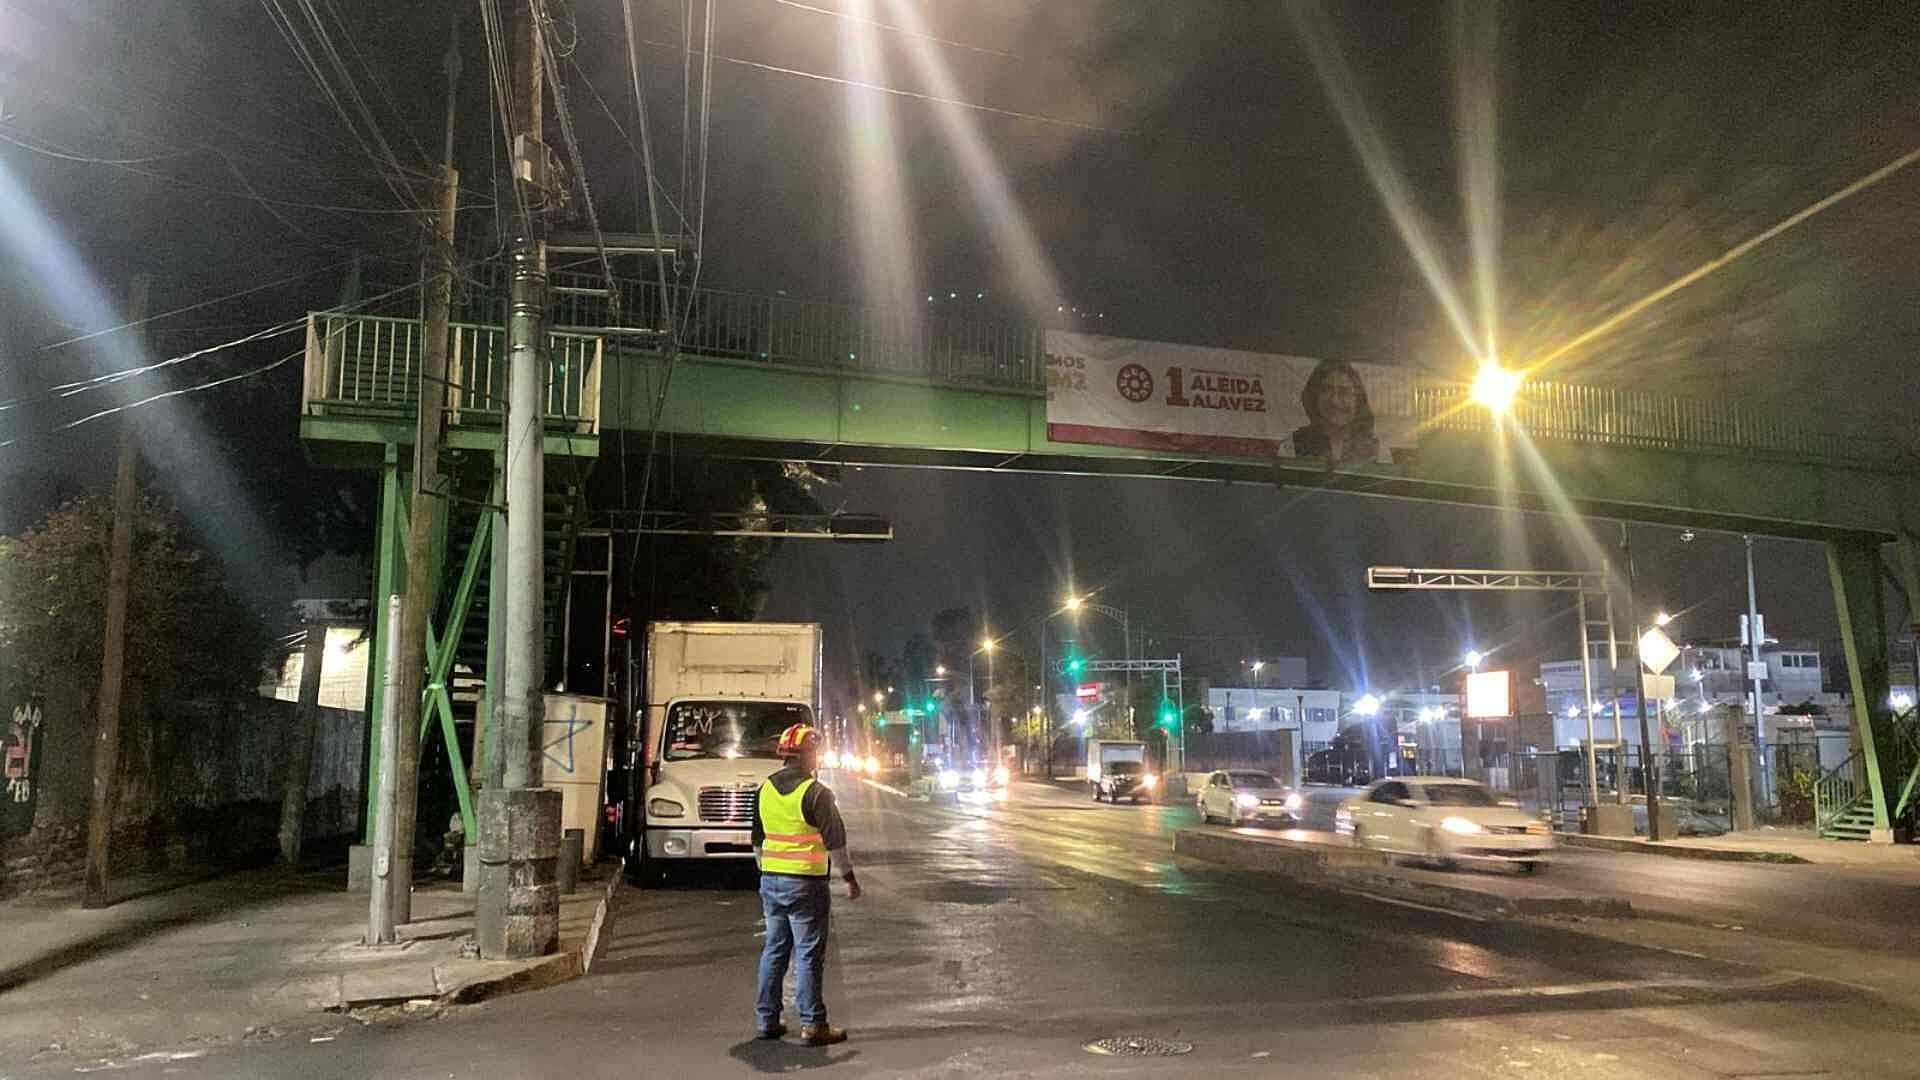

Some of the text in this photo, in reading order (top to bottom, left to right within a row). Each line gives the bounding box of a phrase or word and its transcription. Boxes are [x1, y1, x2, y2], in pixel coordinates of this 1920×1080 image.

[1165, 366, 1189, 407] 1
[1191, 375, 1264, 396] ALEIDA
[1192, 393, 1266, 413] ALAVEZ
